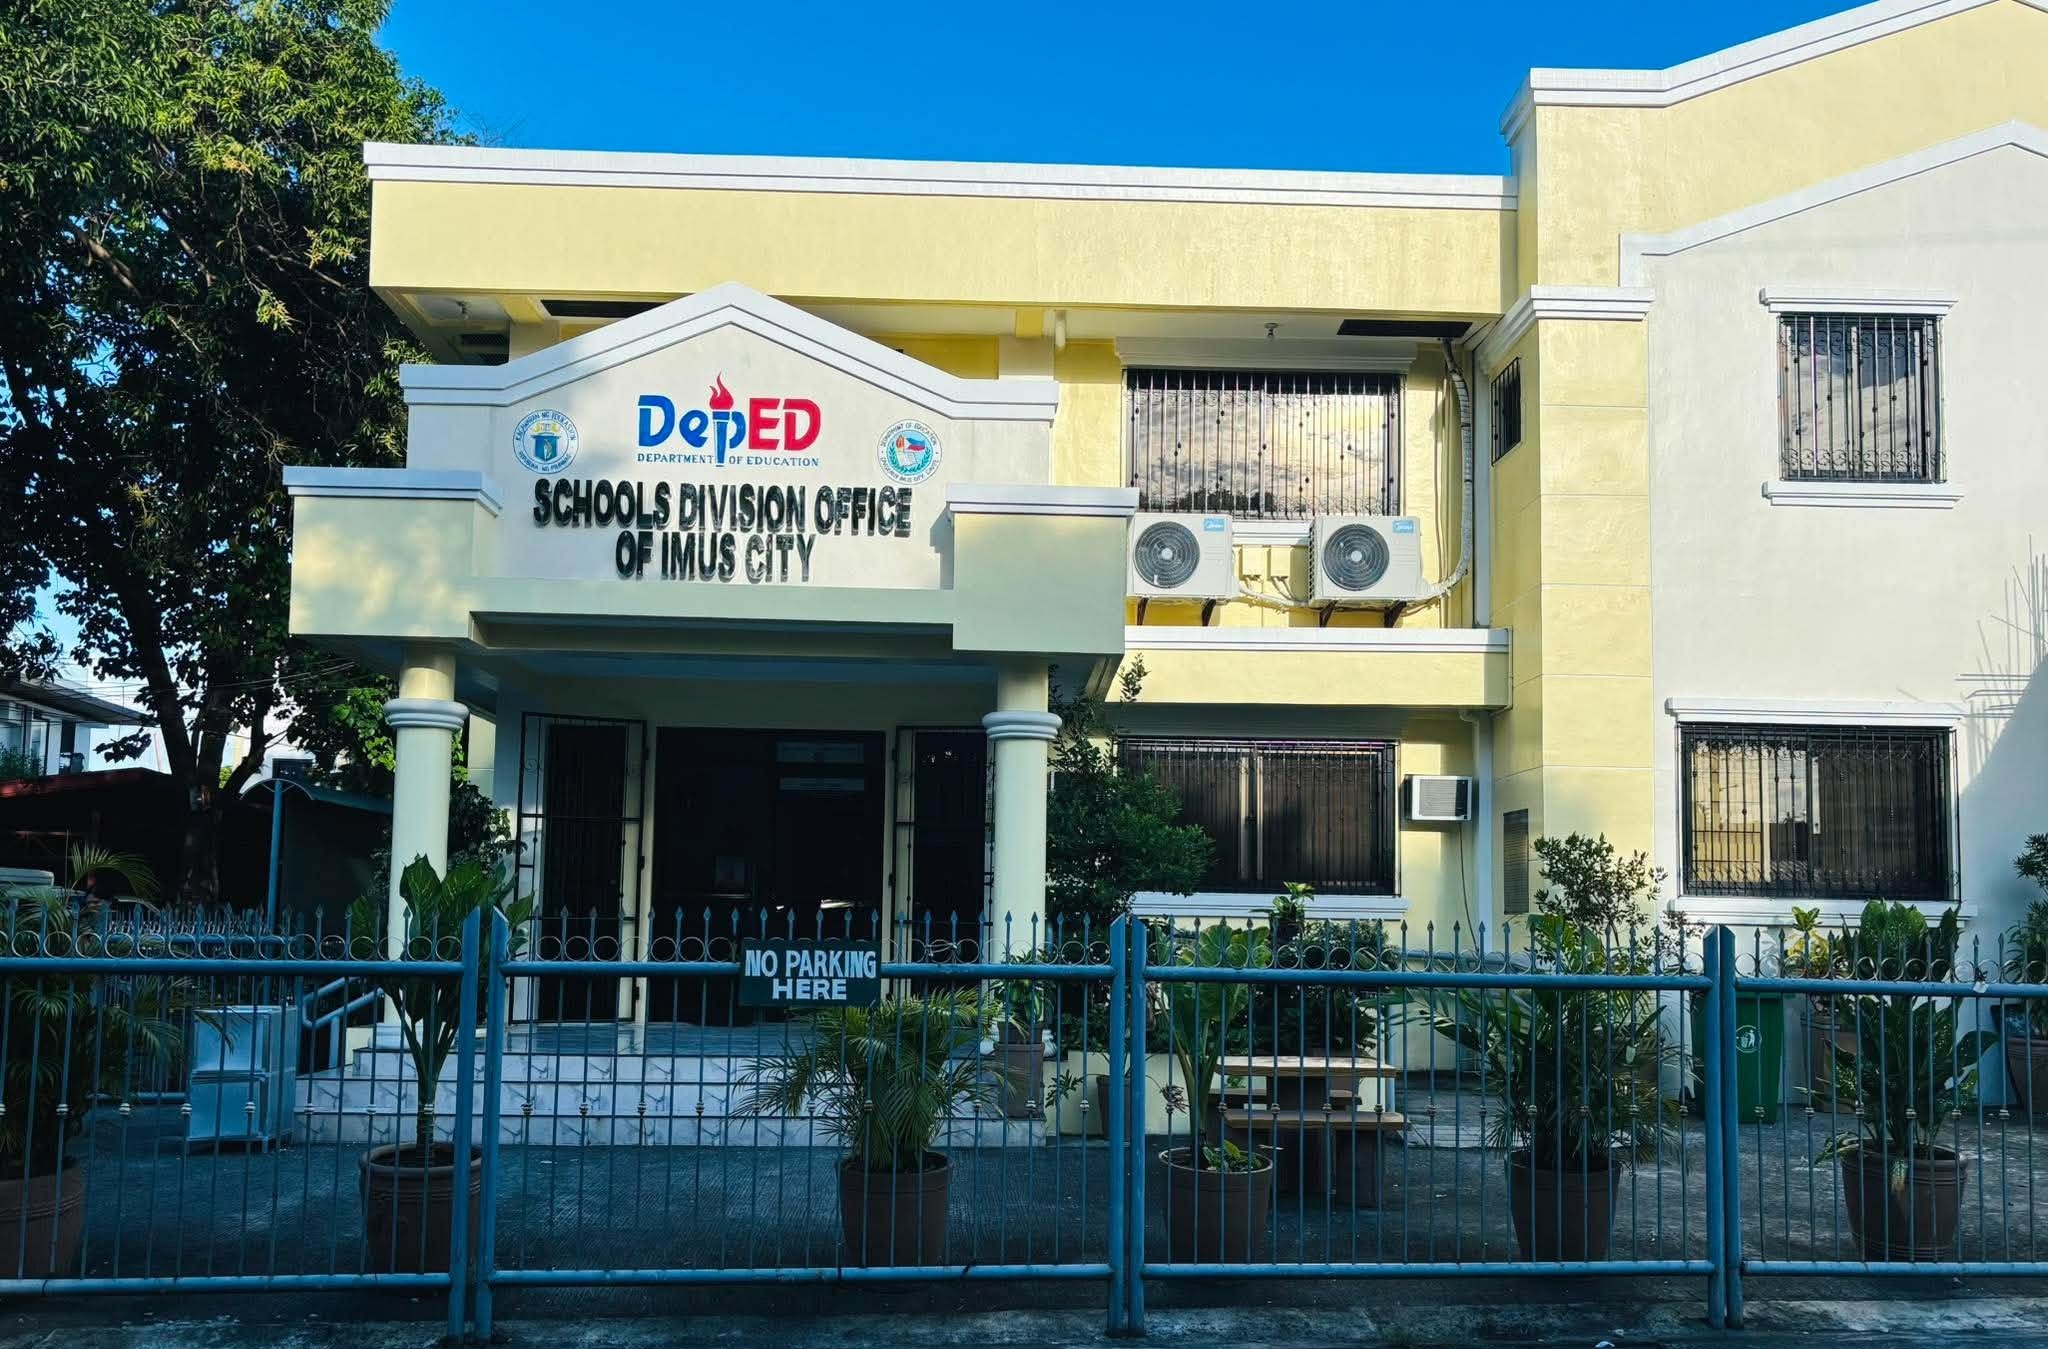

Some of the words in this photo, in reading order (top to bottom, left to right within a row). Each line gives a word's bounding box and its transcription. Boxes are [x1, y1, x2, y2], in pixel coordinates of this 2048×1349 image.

[638, 394, 821, 467] DepED
[637, 453, 713, 465] DEPARTMENT
[728, 456, 743, 465] OF
[746, 456, 819, 467] EDUCATION
[533, 478, 671, 530] SCHOOLS
[679, 482, 806, 534] DIVISION
[814, 485, 912, 538] OFFICE
[616, 530, 654, 581] OF
[661, 531, 736, 583] IMUS
[745, 534, 816, 584] CITY
[745, 950, 778, 977] NO
[785, 950, 877, 979] PARKING
[772, 978, 848, 1000] HERE
